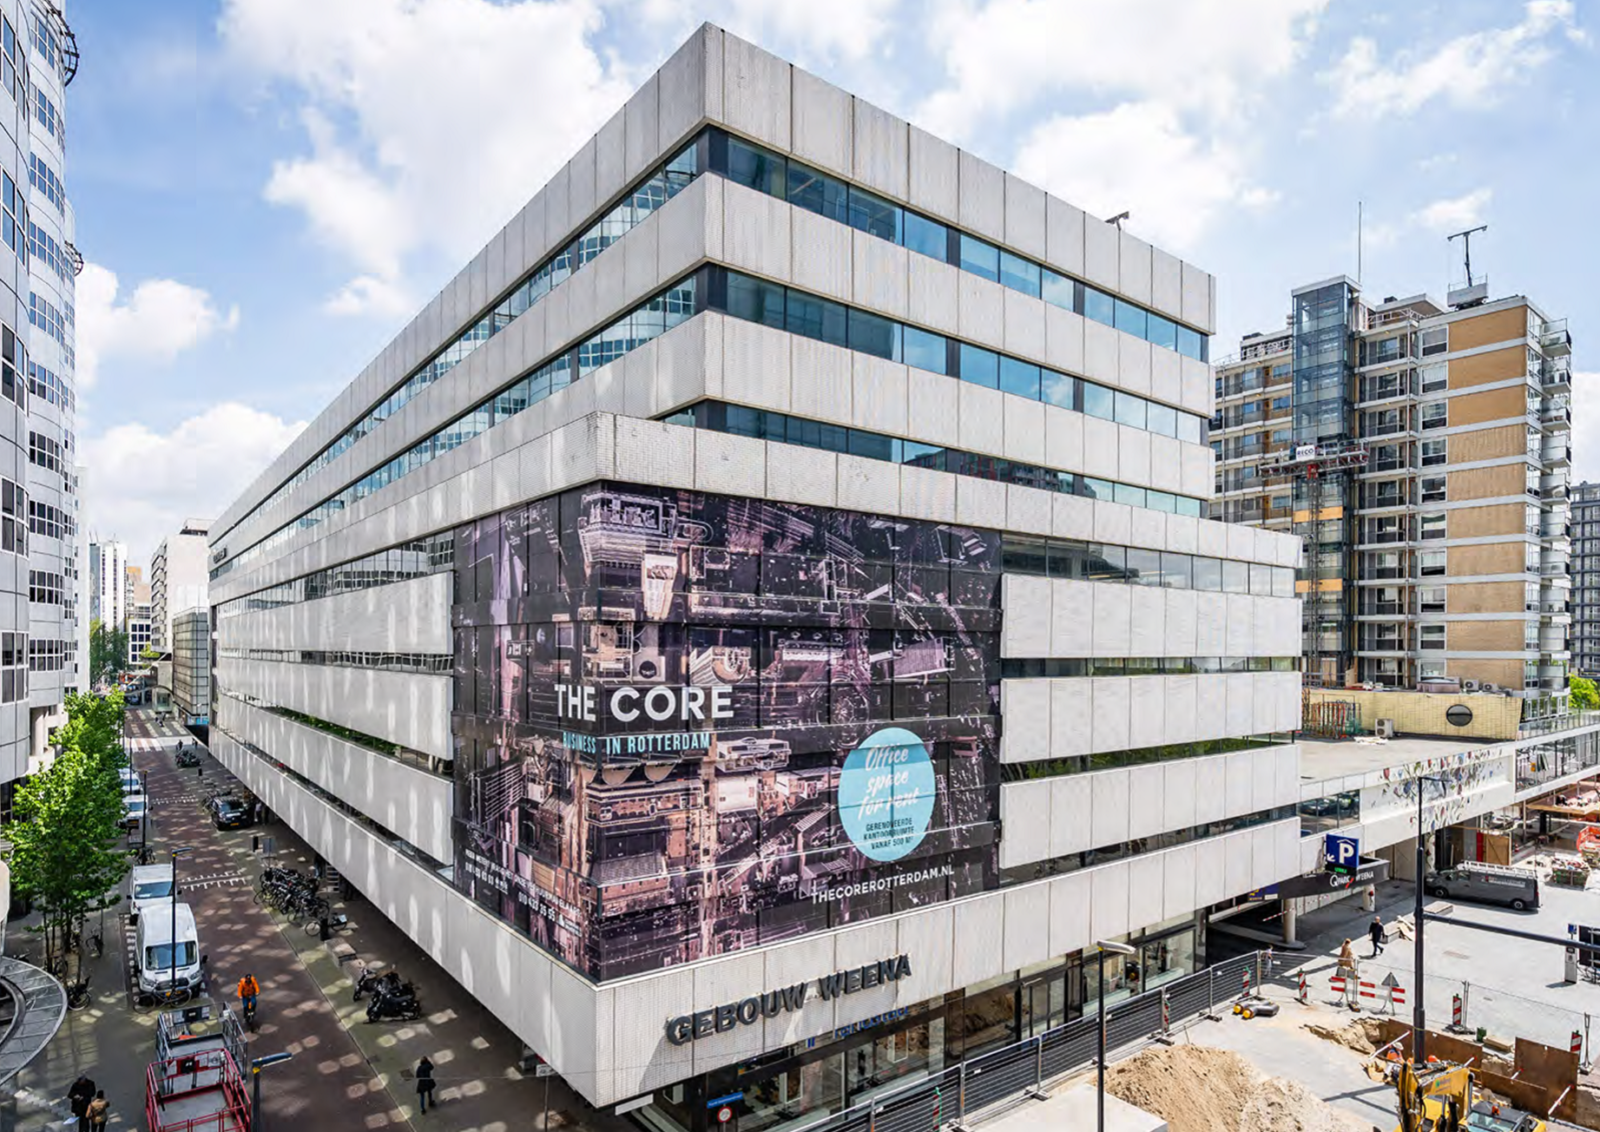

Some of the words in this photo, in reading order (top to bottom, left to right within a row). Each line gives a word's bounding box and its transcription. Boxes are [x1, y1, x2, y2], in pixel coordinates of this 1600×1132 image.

[554, 684, 596, 721] THE
[610, 685, 734, 722] CORE
[562, 732, 596, 754] BUSINESS
[606, 738, 620, 754] IN
[627, 732, 710, 753] ROTTERDAM
[865, 744, 909, 771] Office
[866, 770, 909, 797] space
[858, 795, 884, 820] for
[886, 787, 920, 811] rent
[871, 839, 891, 850] VANAF
[1339, 843, 1354, 864] P
[811, 864, 955, 904] THECOREROTTERDAM.NL
[667, 981, 808, 1046] GEBOUW
[819, 953, 912, 1001] WEENA
